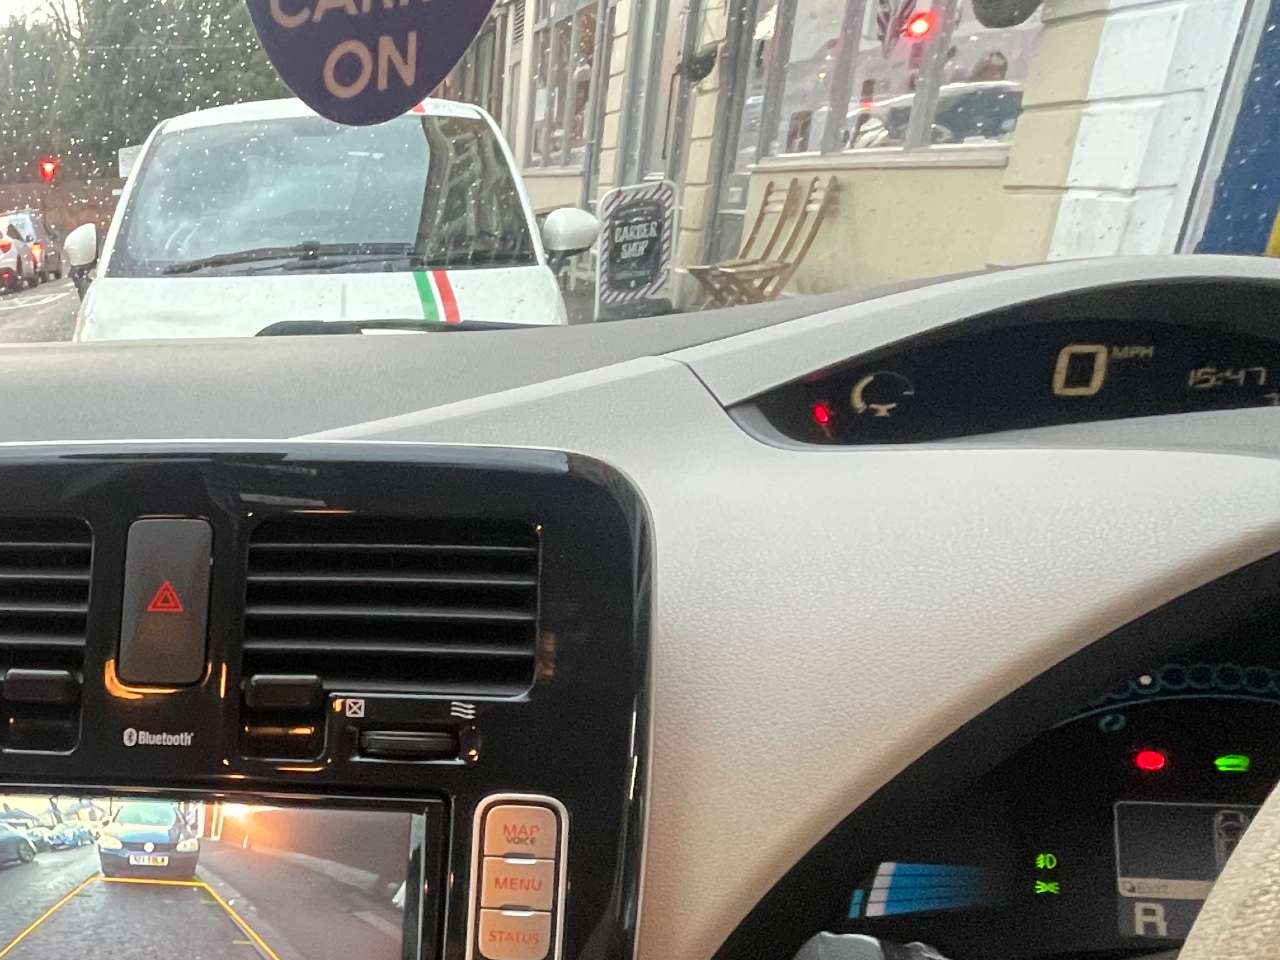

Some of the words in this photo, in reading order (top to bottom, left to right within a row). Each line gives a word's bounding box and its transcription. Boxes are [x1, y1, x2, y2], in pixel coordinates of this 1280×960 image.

[323, 31, 417, 98] ON
[615, 221, 658, 243] BARBER
[621, 239, 648, 259] SHOP
[1052, 344, 1108, 396] 0
[1110, 346, 1154, 359] MPH
[1187, 366, 1267, 390] 15:47
[138, 731, 192, 746] Bluetooth
[503, 823, 540, 837] MAP
[506, 836, 537, 846] VOICE
[494, 877, 542, 892] MENU
[1135, 902, 1167, 936] R
[488, 930, 540, 945] STATUS
